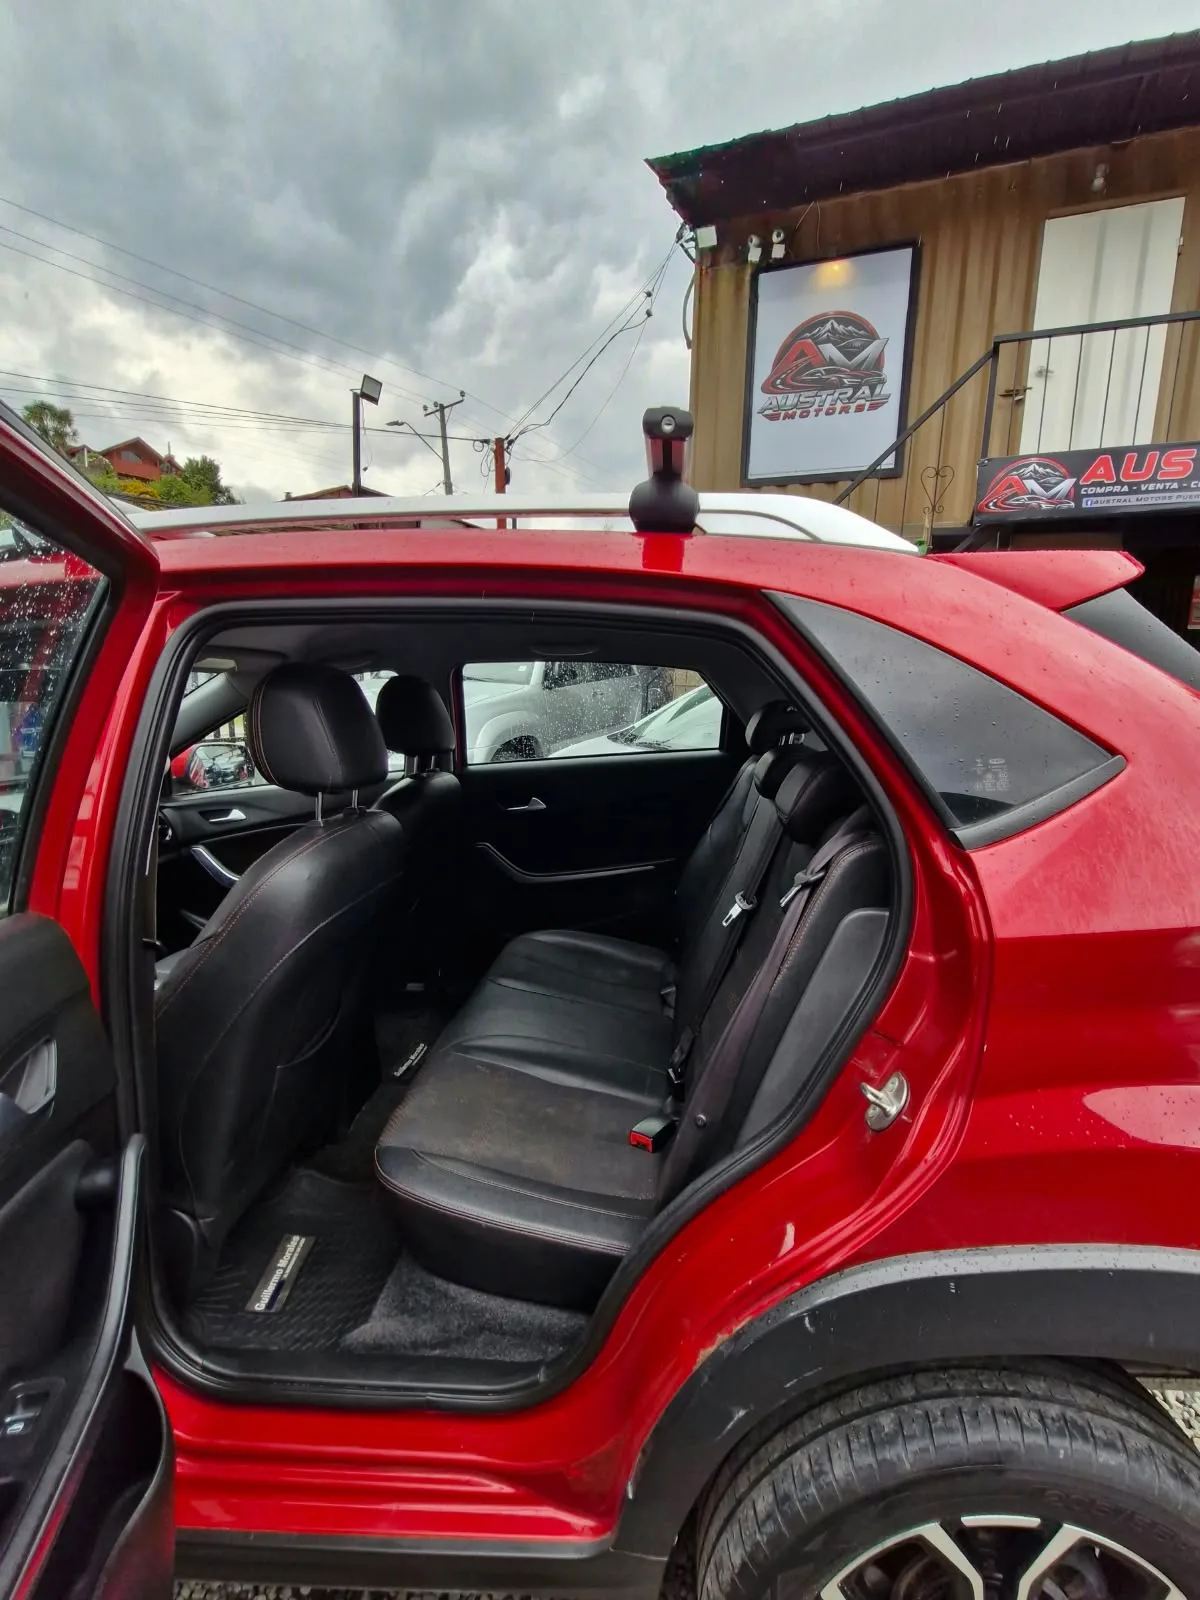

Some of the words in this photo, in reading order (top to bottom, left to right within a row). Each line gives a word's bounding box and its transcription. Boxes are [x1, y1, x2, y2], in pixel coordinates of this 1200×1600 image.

[757, 383, 891, 415] AUSTRAL
[781, 402, 866, 421] MOTORS
[1080, 484, 1129, 495] COMPRA
[1140, 481, 1179, 491] VENTA
[254, 1268, 284, 1311] Guillermo
[277, 1235, 300, 1269] Morales
